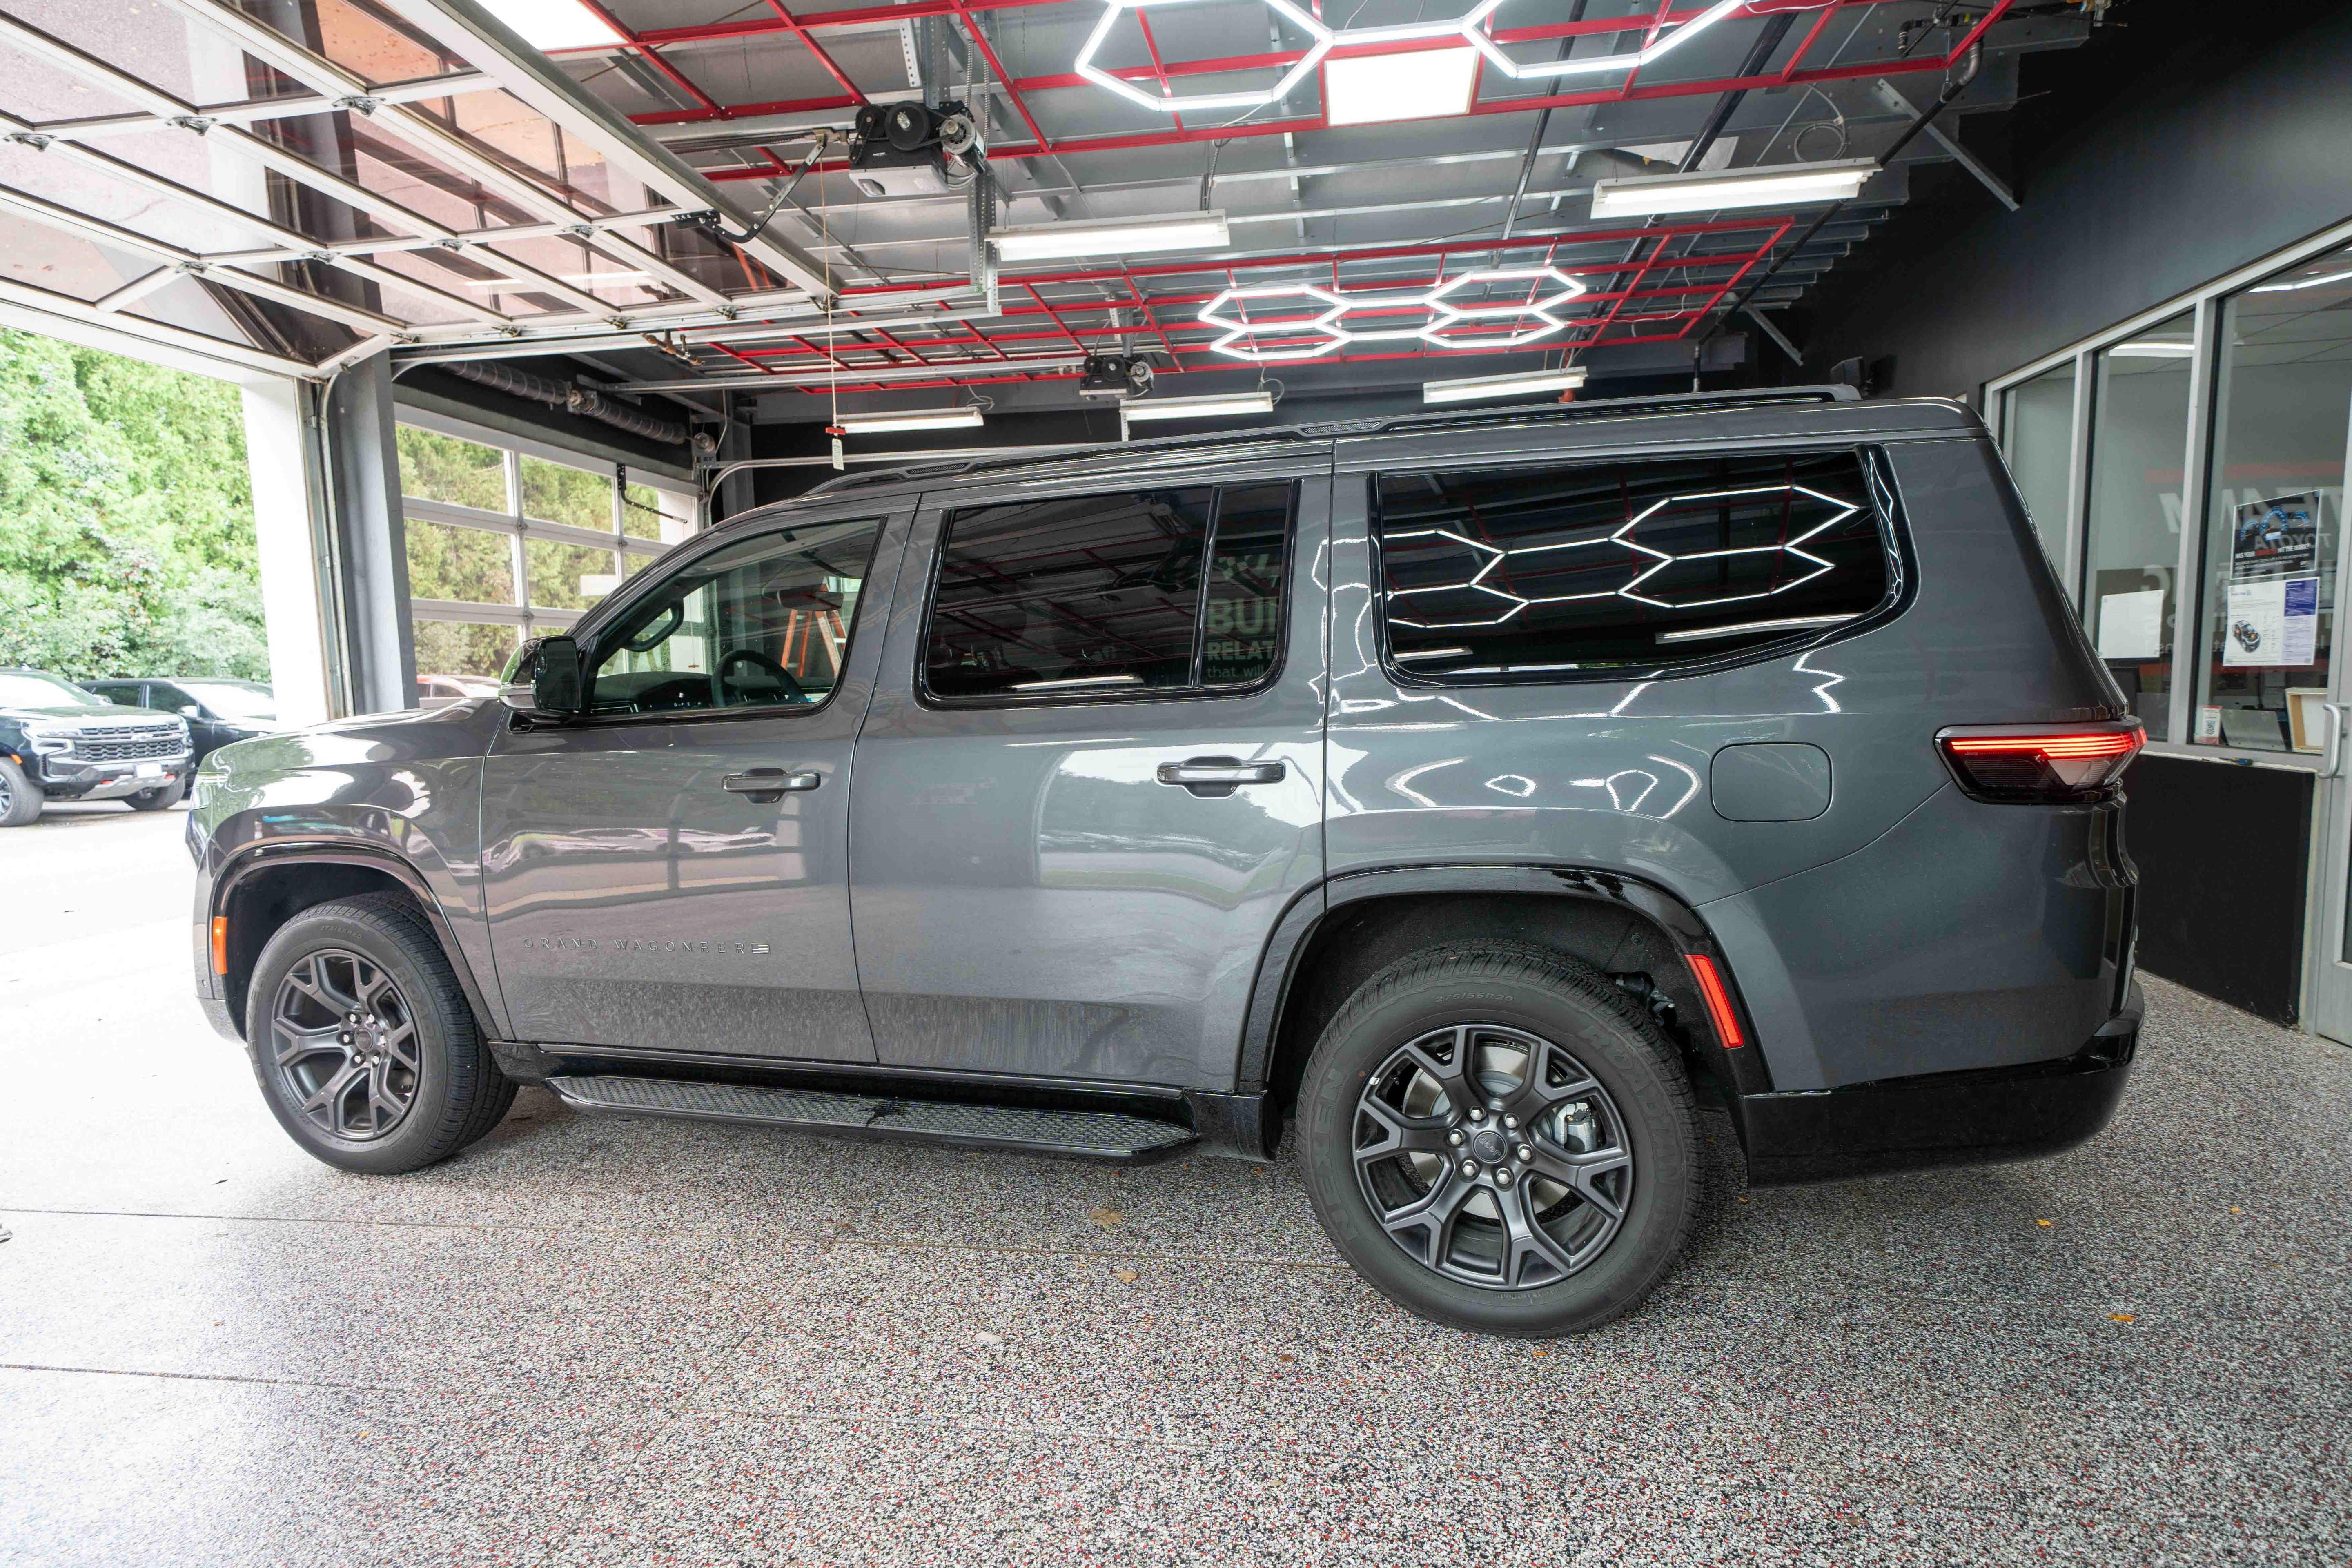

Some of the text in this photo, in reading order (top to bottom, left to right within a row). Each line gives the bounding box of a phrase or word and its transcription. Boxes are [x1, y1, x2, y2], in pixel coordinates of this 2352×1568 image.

[1206, 664, 1264, 678] that will
[523, 937, 746, 955] GRAND WAGONEER
[1435, 992, 1515, 1003] 275/55R20
[1313, 1067, 1361, 1240] NEXEN
[1479, 1137, 1501, 1156] Jeep
